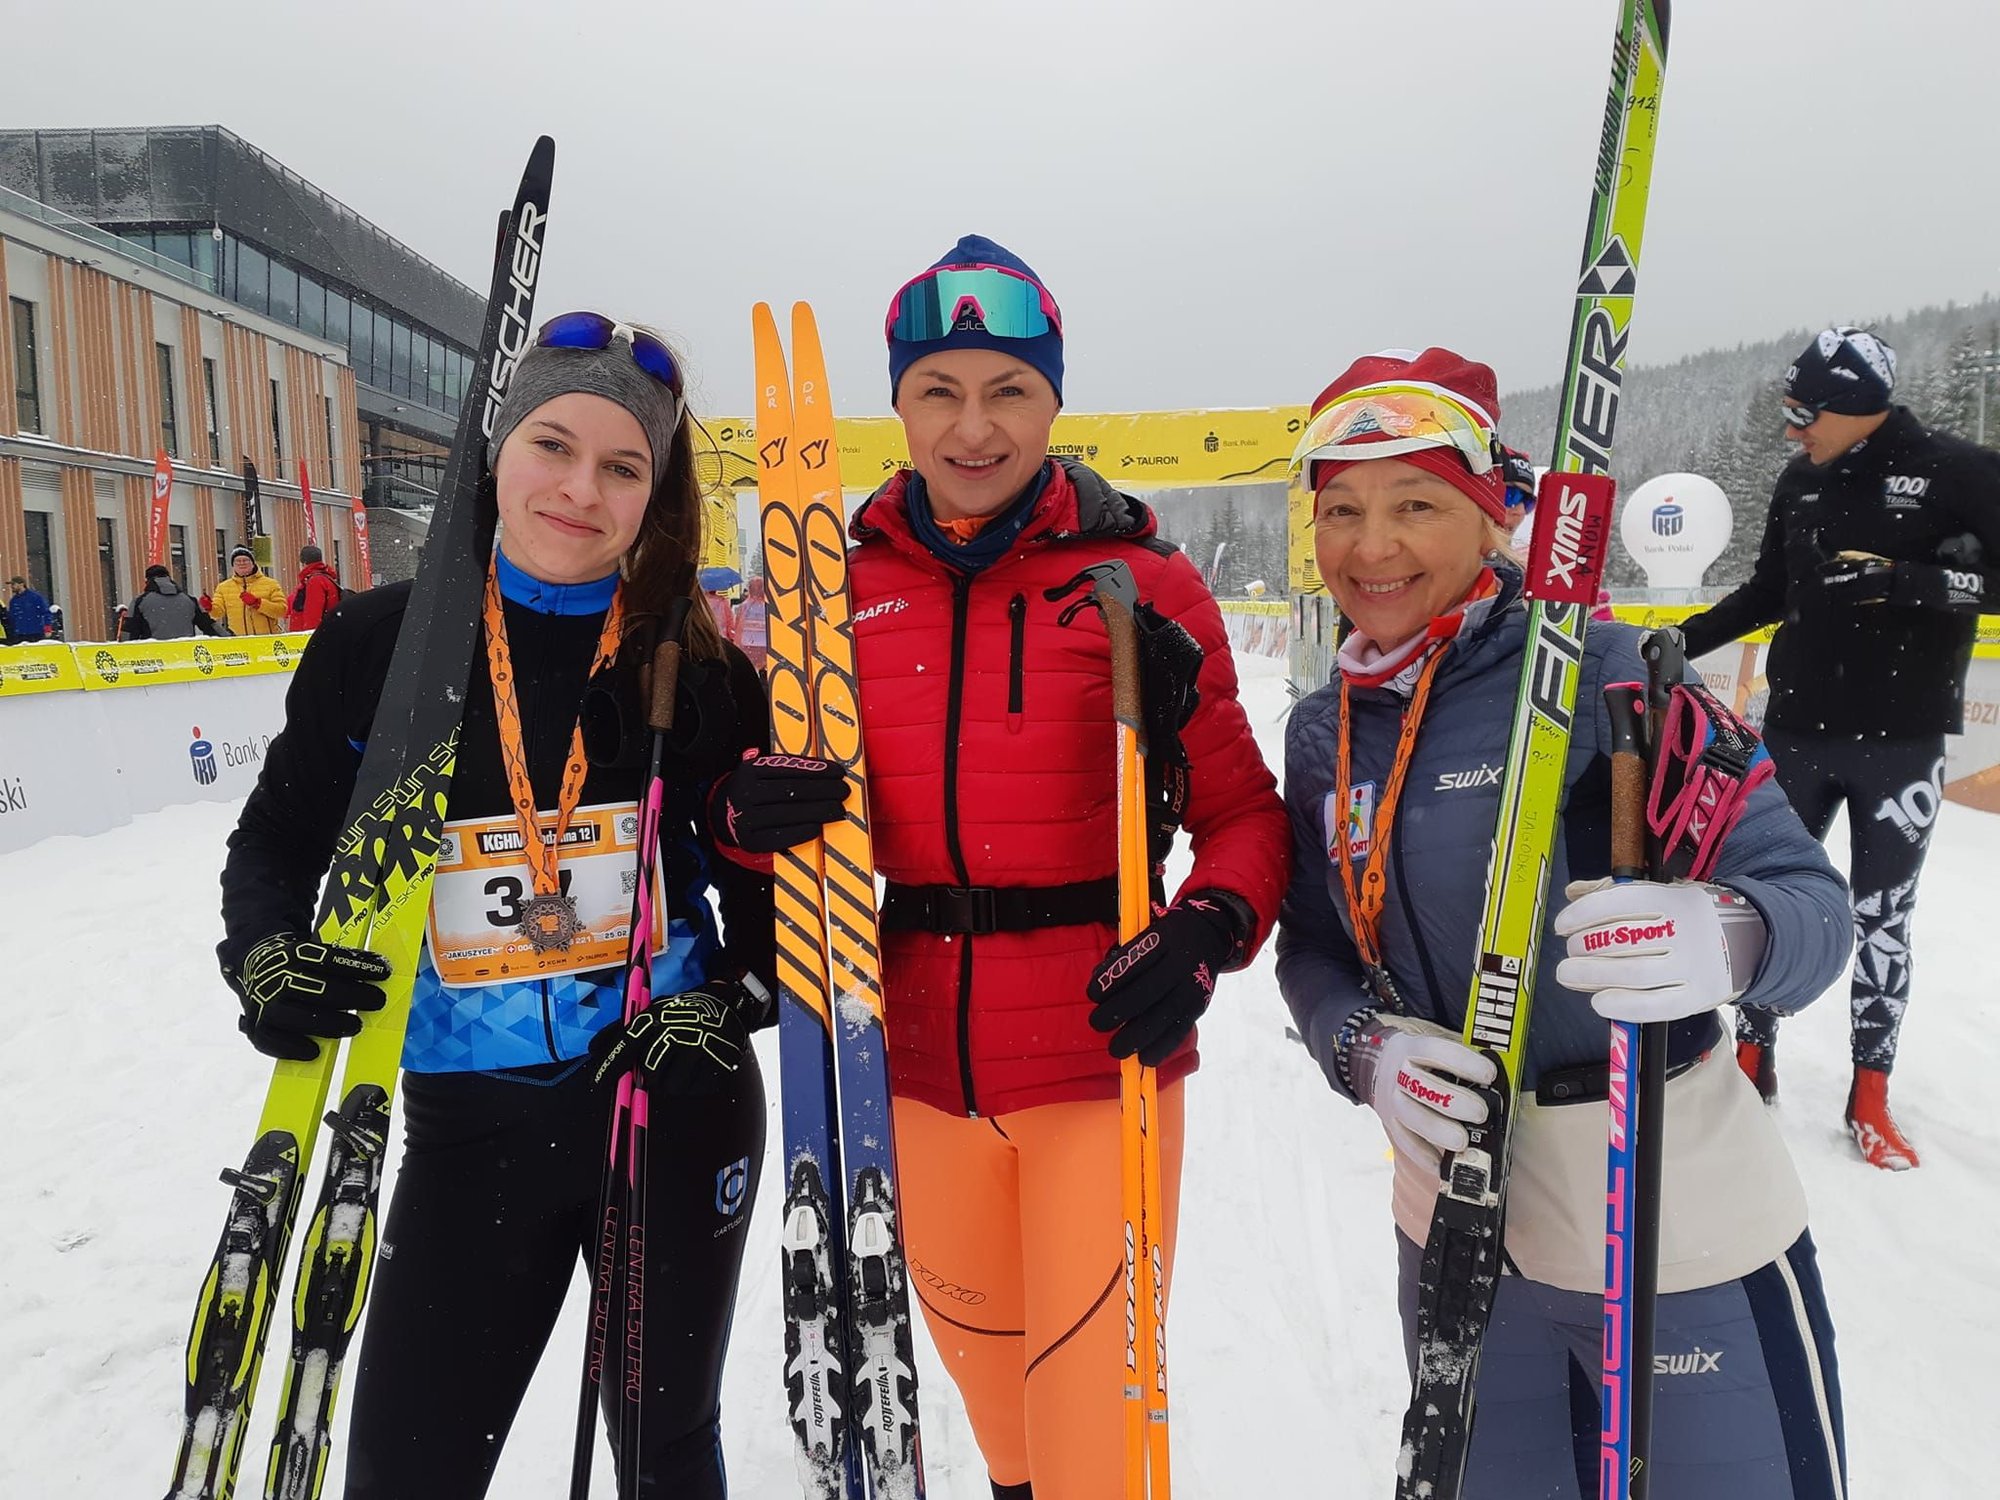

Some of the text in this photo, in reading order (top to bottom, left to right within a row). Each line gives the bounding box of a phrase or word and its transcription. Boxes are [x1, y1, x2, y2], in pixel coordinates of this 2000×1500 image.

[955, 321, 986, 331] dlo
[737, 429, 757, 438] KG
[1048, 444, 1083, 453] ASTÓW
[1136, 456, 1179, 466] TAURON
[1644, 544, 1694, 553] Bank Polski
[853, 601, 894, 623] RAFT
[761, 501, 812, 759] OKO
[221, 736, 260, 768] Bank
[753, 756, 828, 772] YOKO
[579, 828, 591, 841] 12
[420, 862, 435, 881] PRO
[484, 869, 572, 928] 37
[447, 948, 493, 960] JAKUSZYCE
[1098, 931, 1160, 992] YOKO
[333, 956, 385, 974] NORDIC SPORT
[594, 1039, 626, 1084] NORDIC SPORT
[628, 1224, 645, 1311] CENTRA
[910, 1258, 986, 1305] YOKO
[626, 1356, 641, 1404] PRO
